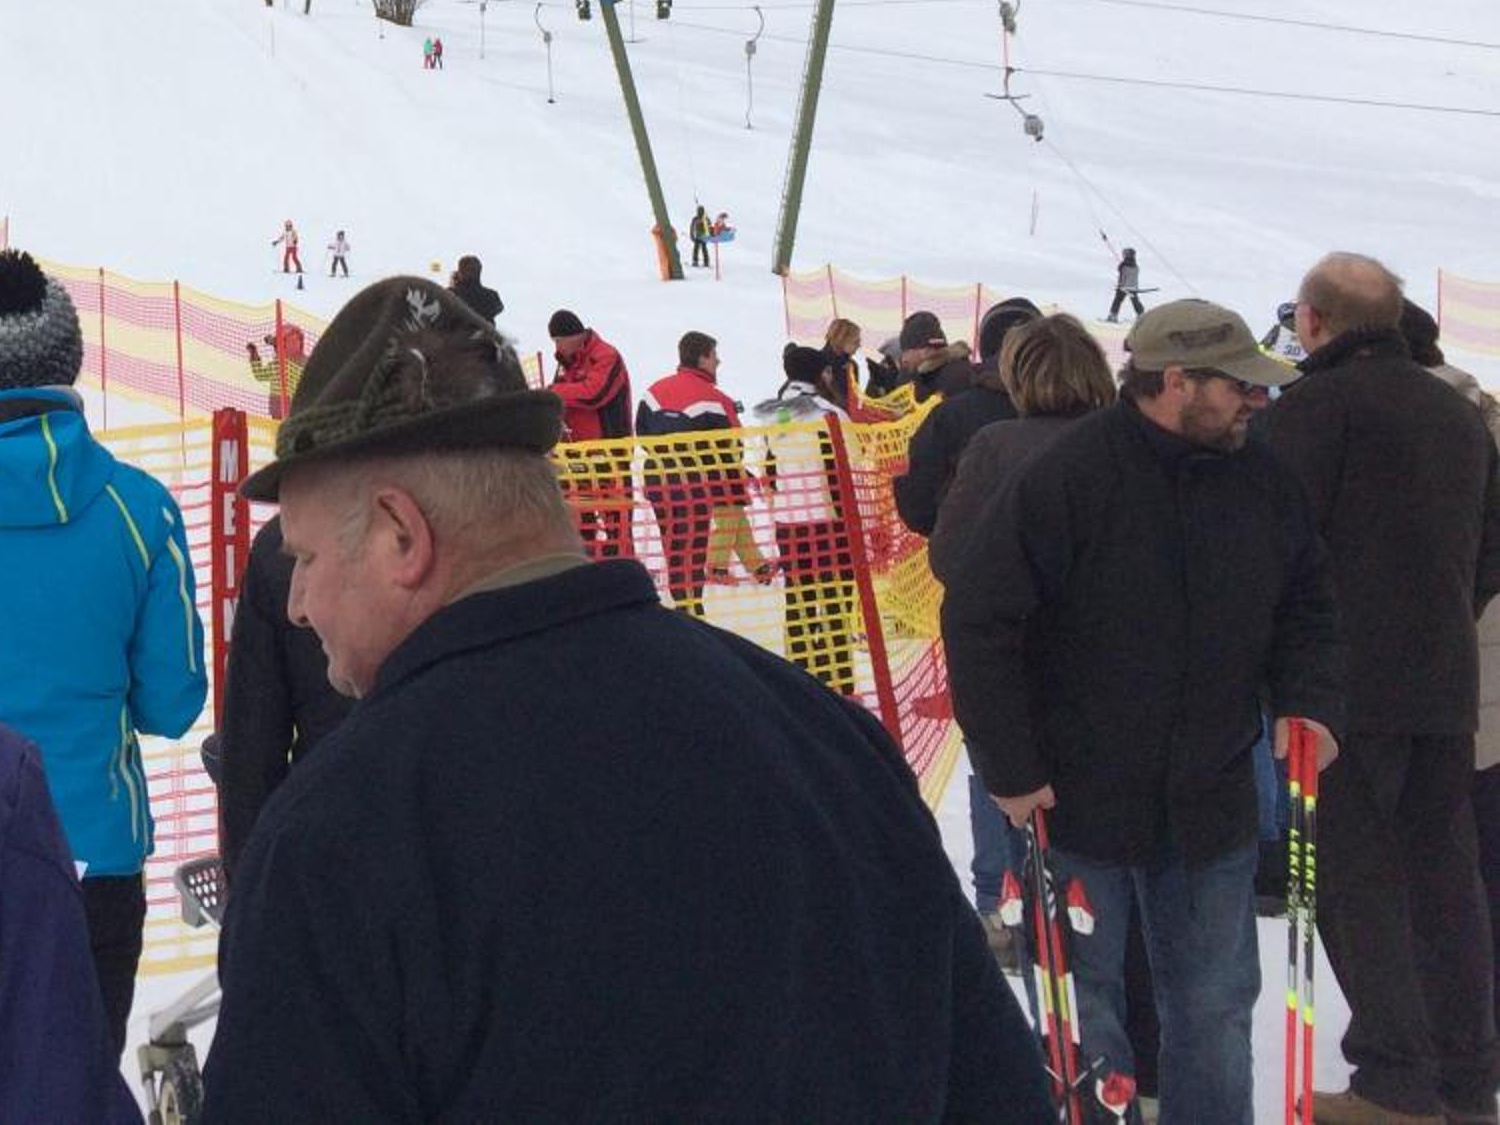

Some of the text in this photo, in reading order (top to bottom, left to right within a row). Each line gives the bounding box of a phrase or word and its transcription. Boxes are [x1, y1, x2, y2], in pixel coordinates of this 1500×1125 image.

[219, 439, 239, 673] MEIN
[1289, 828, 1300, 876] LEKI
[1305, 842, 1316, 891] LEKI
